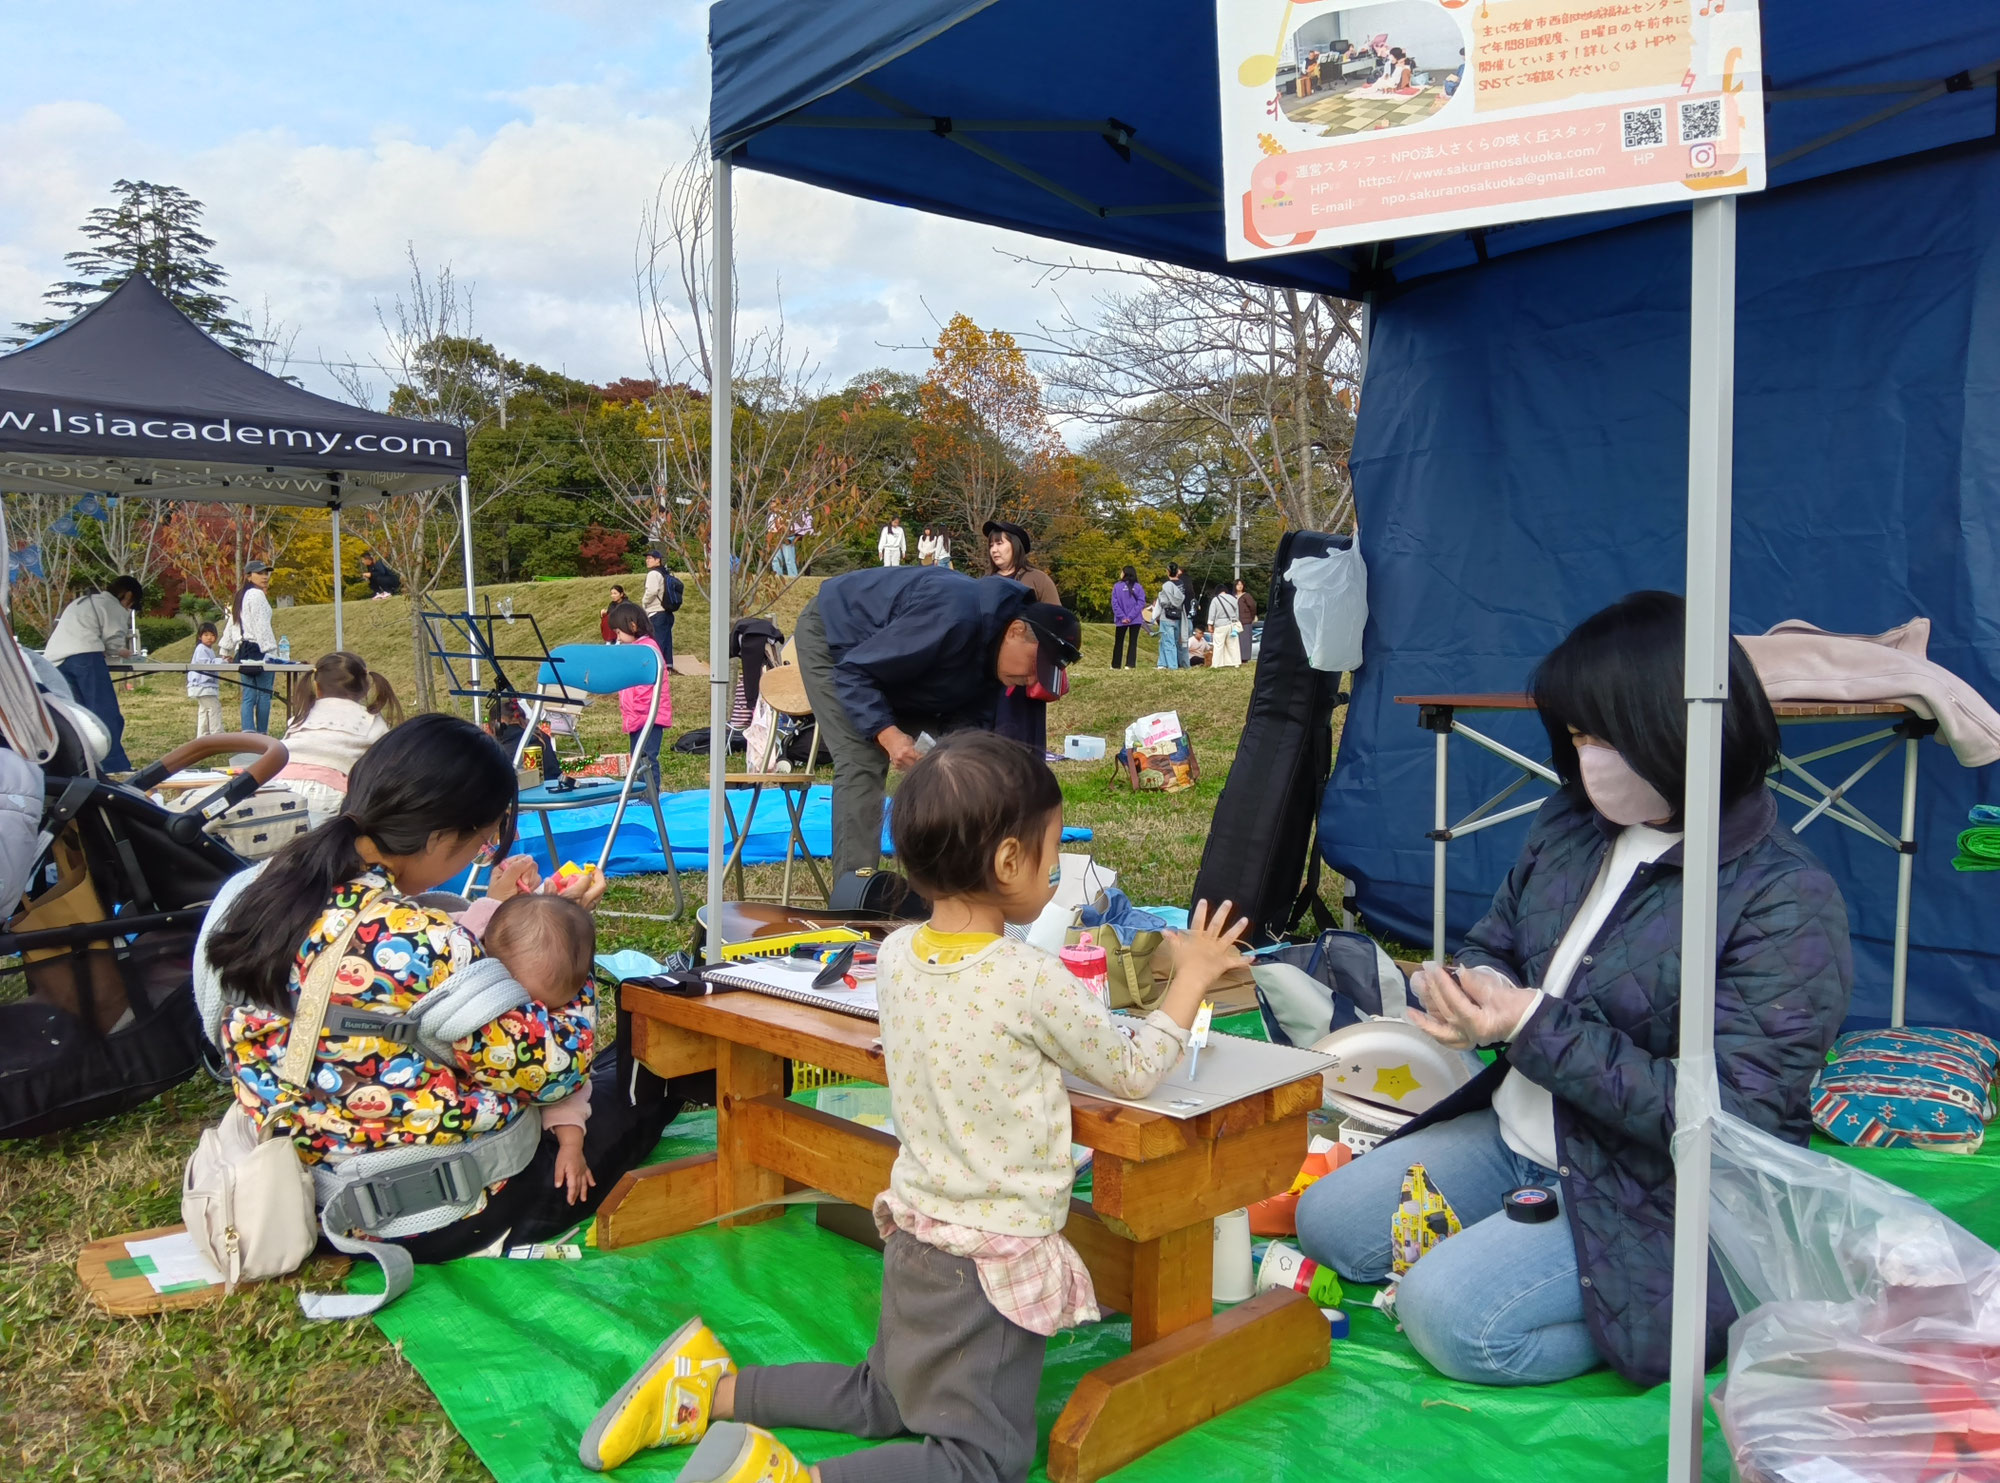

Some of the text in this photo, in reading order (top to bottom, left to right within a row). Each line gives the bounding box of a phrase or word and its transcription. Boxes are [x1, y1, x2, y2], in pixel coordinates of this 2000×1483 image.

[1358, 144, 1602, 188] https://www.sakuranosakuoka.com/
[1634, 152, 1654, 166] HP
[1685, 169, 1725, 180] Instagram
[1311, 165, 1606, 216] E-mail npo.sakuranosakuoka@gmail.com
